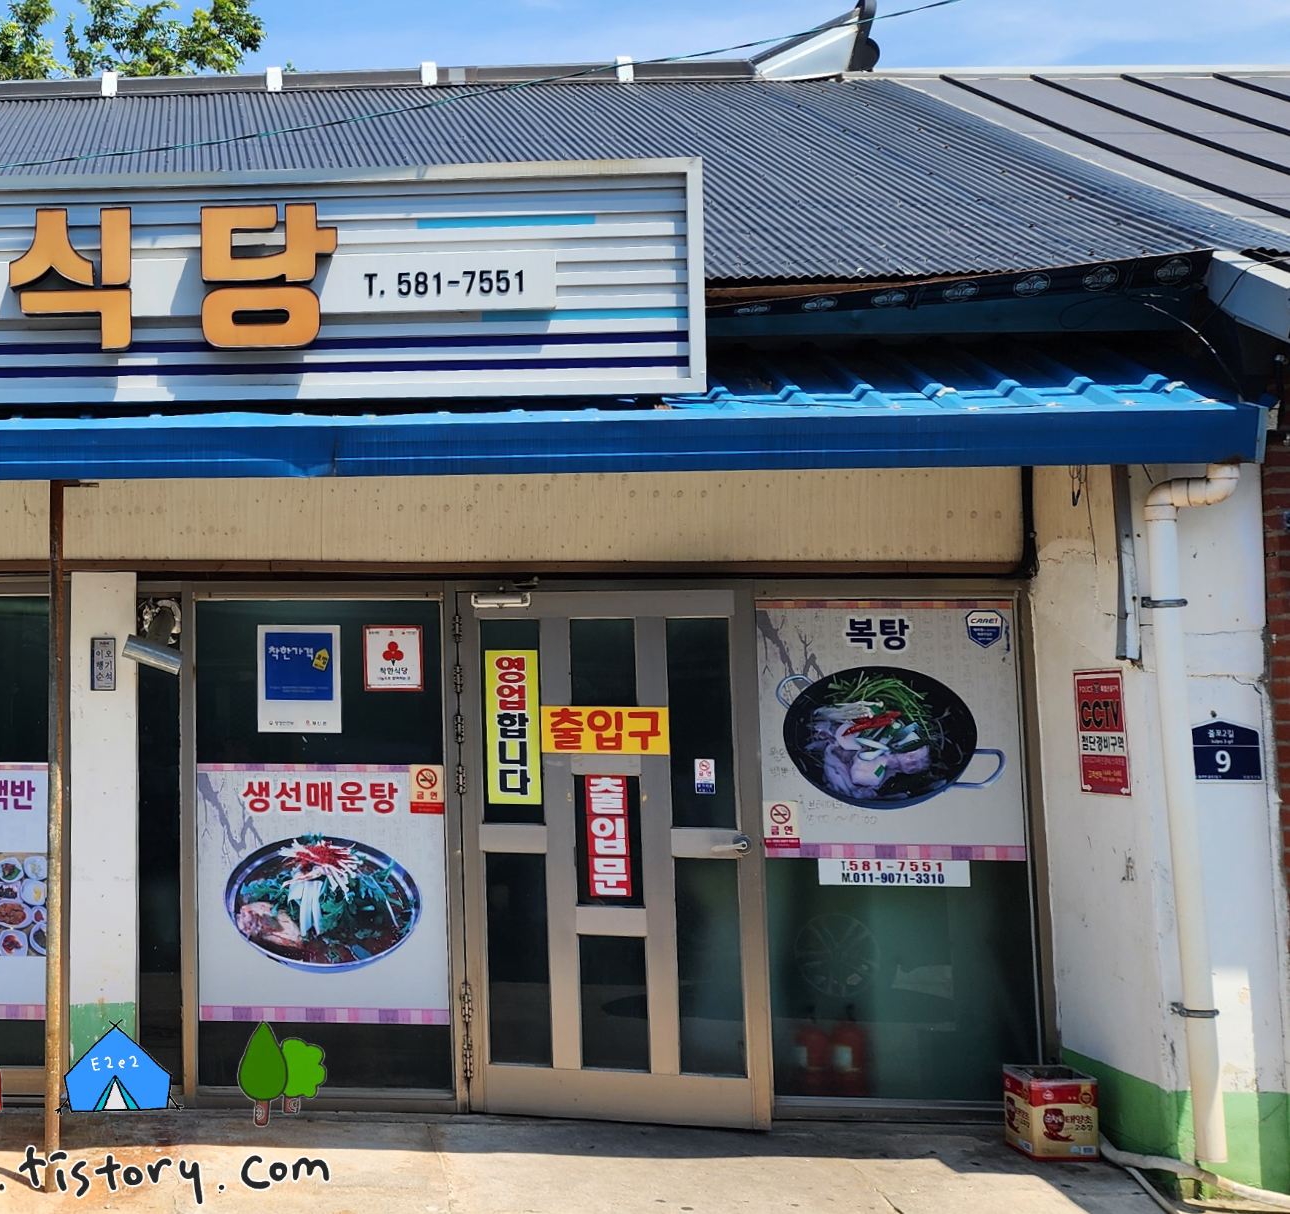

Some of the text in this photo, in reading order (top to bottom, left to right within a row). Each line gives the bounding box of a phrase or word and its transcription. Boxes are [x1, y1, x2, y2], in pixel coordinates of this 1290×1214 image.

[397, 269, 524, 297] 581-7551
[845, 618, 910, 650] 복탕
[268, 645, 314, 661] 착한가격
[379, 667, 408, 675] 착한식당
[495, 655, 531, 796] 영업합니다
[1080, 699, 1120, 728] CCTV
[550, 707, 661, 751] 출입구
[1081, 735, 1125, 752] 첨단경비구역
[1215, 750, 1231, 773] 9
[242, 781, 399, 814] 생선매운탕
[589, 776, 627, 896] 출입문
[841, 872, 945, 884] M.011-9071-3310
[1065, 1115, 1093, 1125] 태양초
